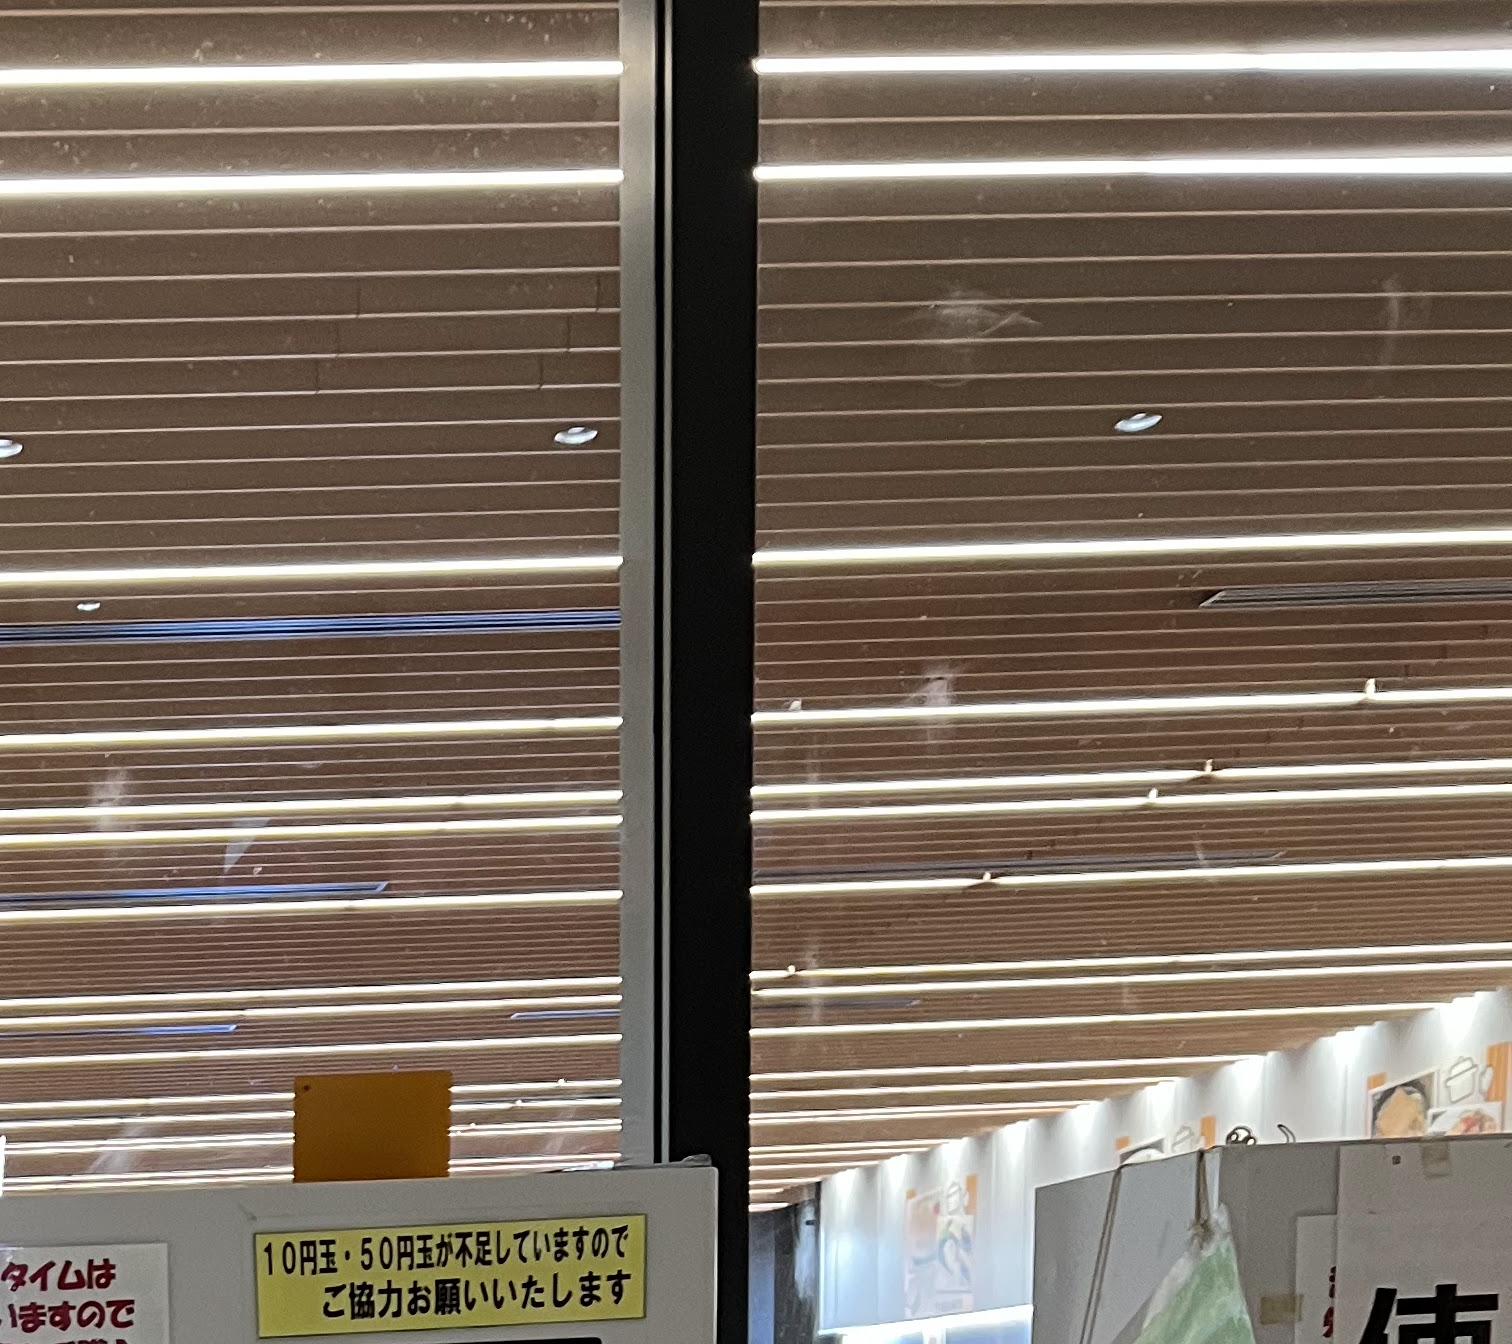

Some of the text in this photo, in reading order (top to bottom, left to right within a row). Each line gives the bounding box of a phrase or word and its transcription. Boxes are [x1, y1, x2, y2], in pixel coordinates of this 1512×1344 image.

[322, 1269, 631, 1320] ご協力お願いいたします
